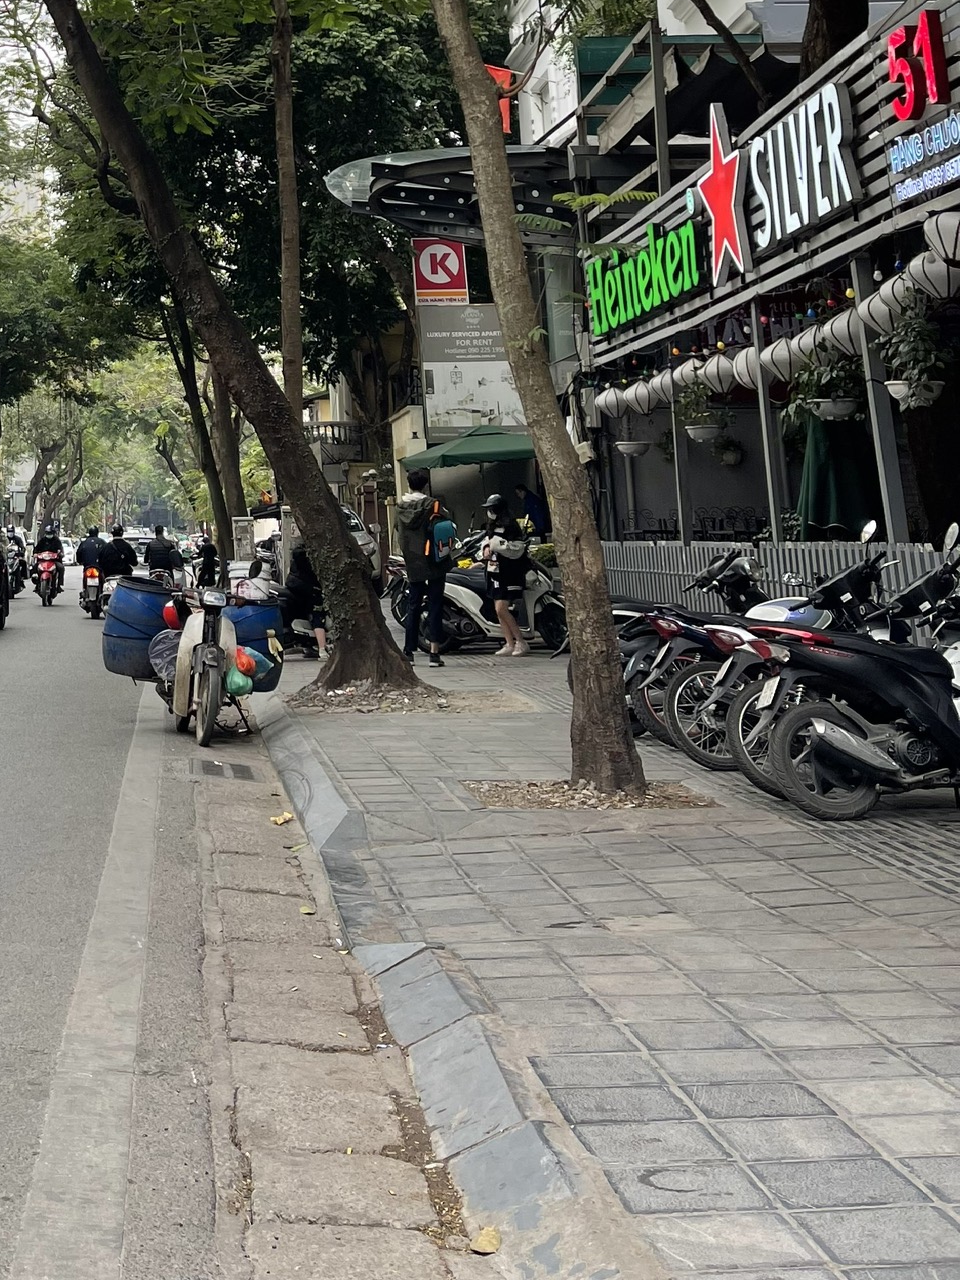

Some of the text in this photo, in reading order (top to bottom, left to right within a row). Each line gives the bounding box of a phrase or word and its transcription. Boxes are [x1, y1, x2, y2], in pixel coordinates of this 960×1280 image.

[888, 10, 942, 120] 51
[749, 82, 854, 248] SILVER
[890, 133, 924, 174] HÀNG
[587, 220, 700, 337] Heineken
